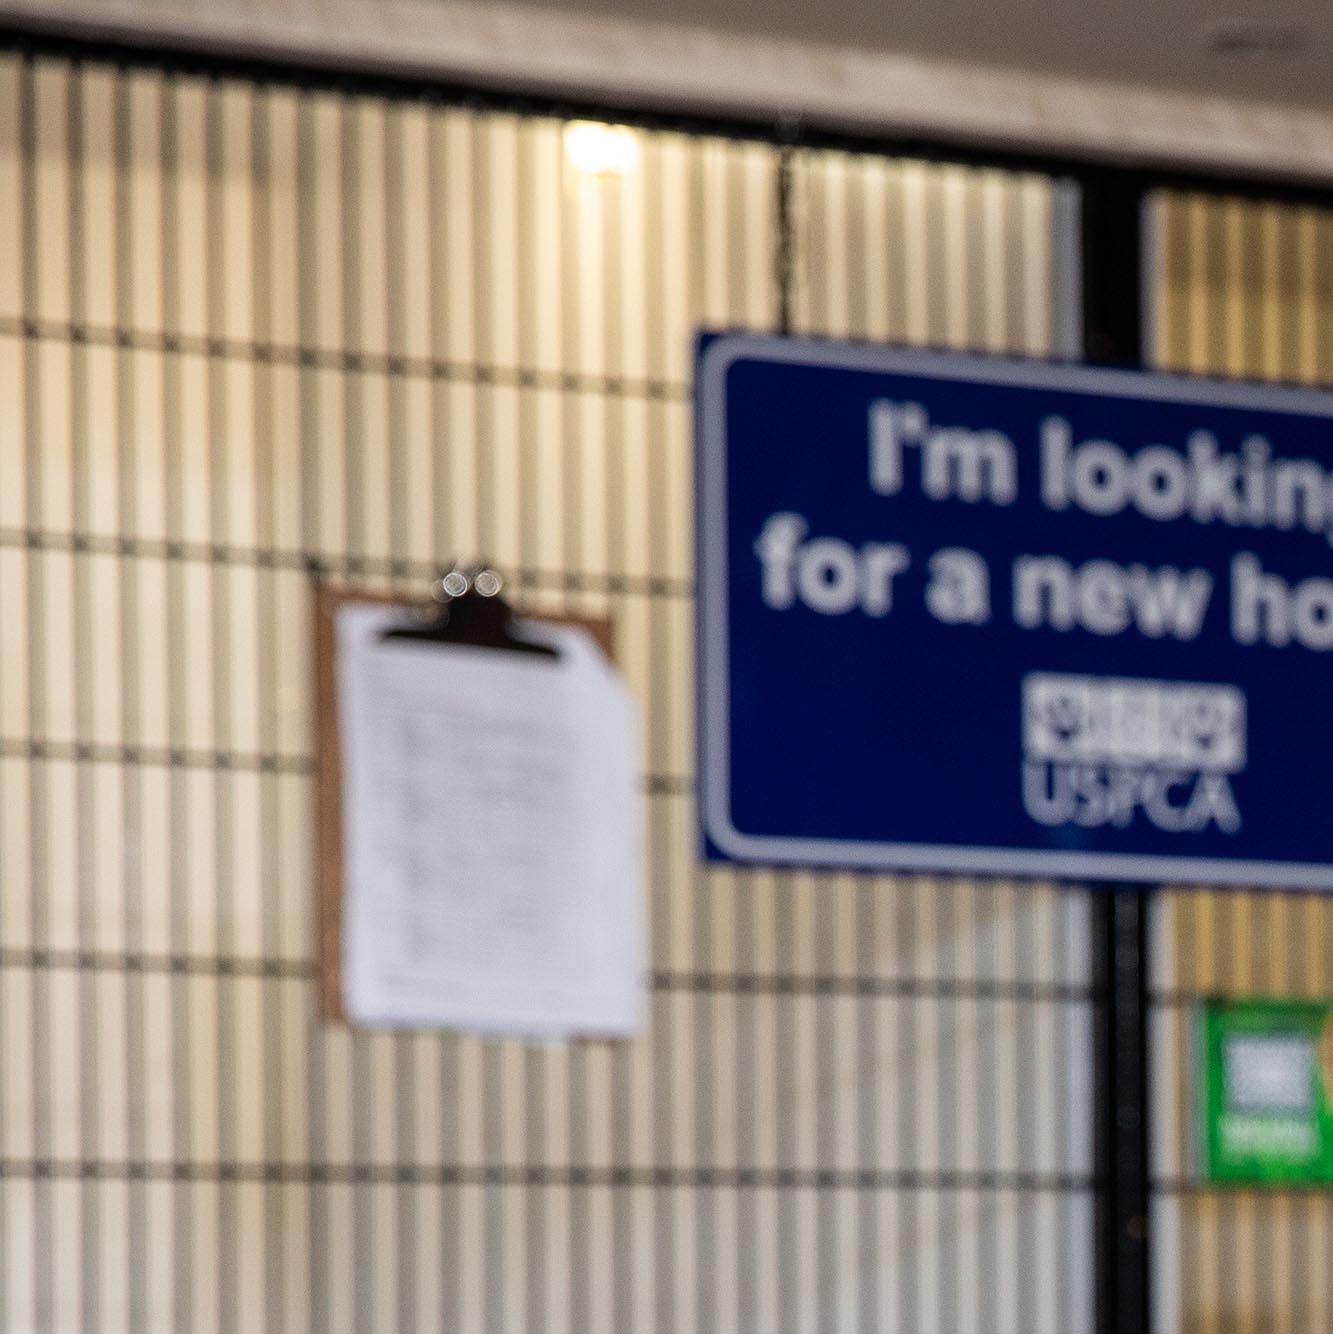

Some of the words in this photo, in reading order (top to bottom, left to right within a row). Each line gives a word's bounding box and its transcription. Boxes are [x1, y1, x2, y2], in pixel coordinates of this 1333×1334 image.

[868, 398, 1018, 508] I'm
[757, 510, 911, 619] for
[924, 546, 990, 628] a
[1010, 552, 1215, 643] new
